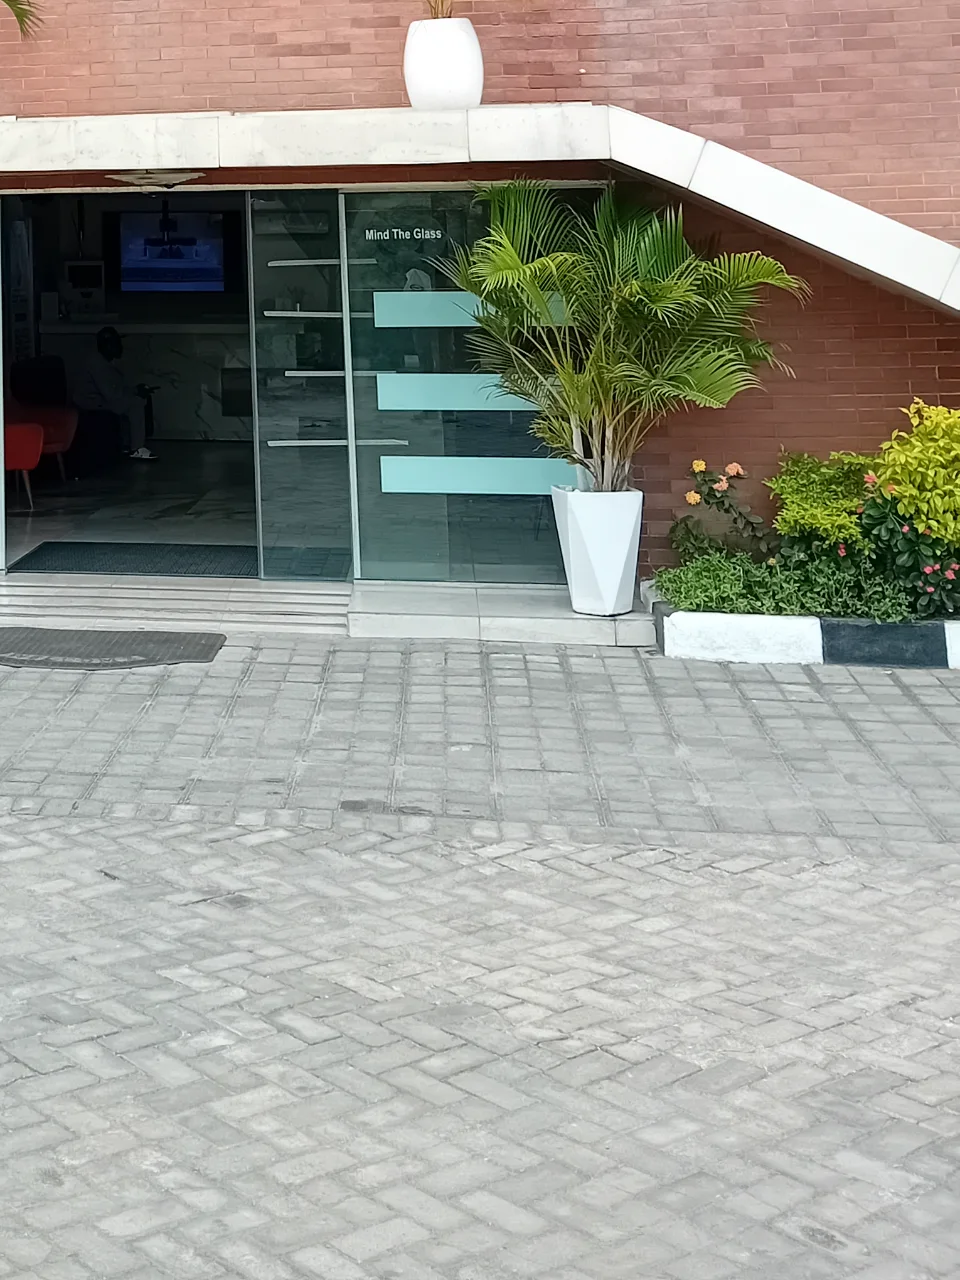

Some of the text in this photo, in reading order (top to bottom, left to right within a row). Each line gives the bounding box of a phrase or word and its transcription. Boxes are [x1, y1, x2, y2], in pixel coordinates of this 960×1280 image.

[365, 228, 442, 240] Mind The Glass
